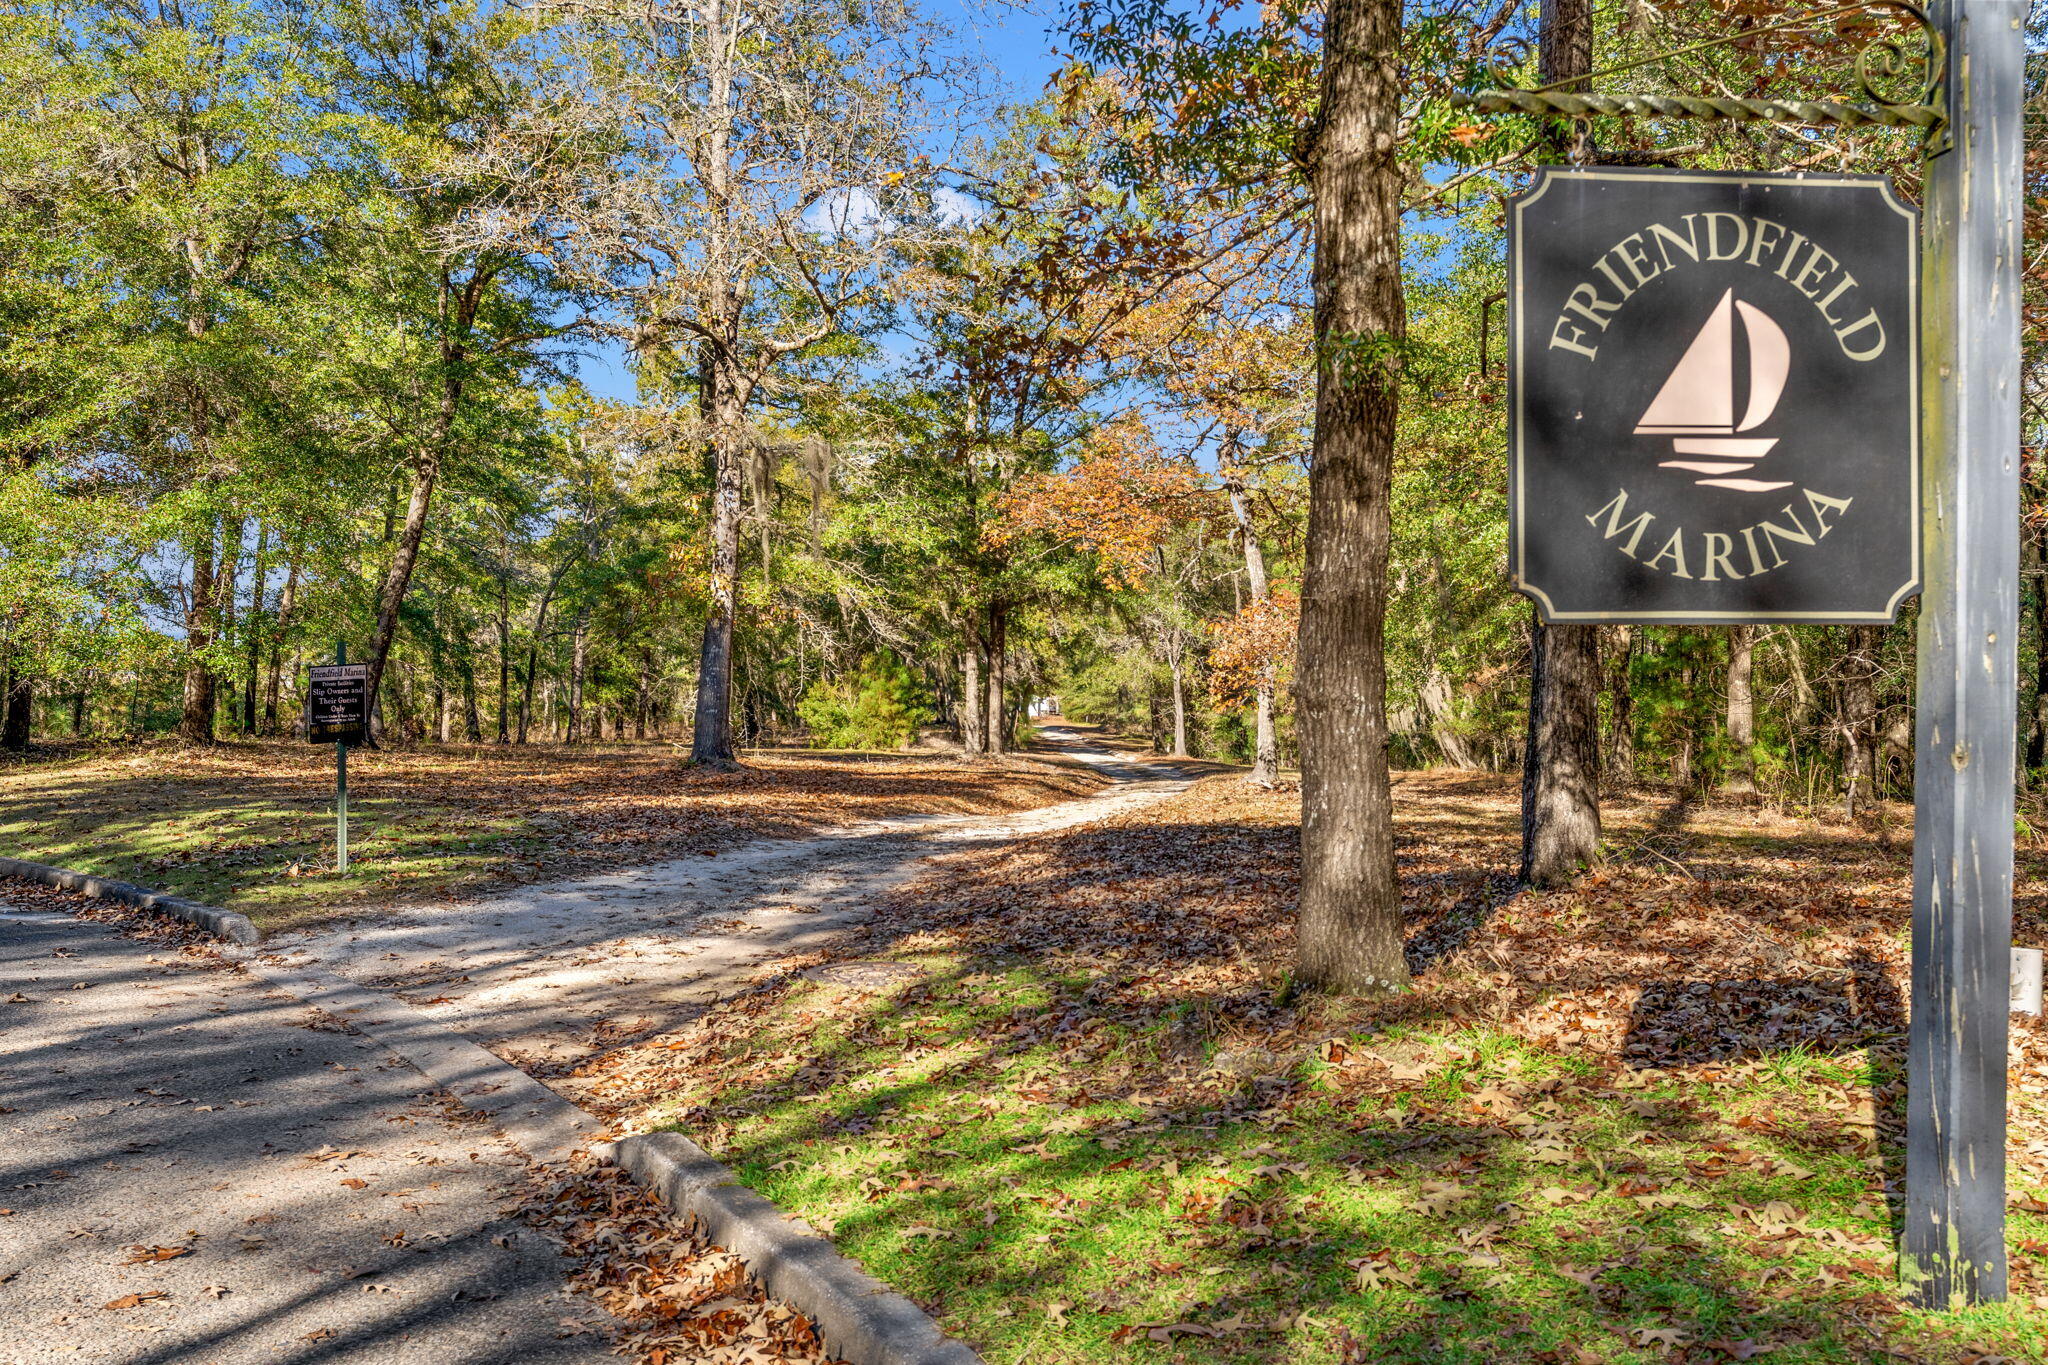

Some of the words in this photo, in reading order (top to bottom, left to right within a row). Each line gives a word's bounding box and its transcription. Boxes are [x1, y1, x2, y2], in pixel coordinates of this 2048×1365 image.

[1548, 211, 1887, 363] FRIENDFIELD
[1585, 488, 1853, 581] MARINA
[311, 668, 343, 678] Friendfield
[344, 667, 366, 677] Marina
[312, 688, 325, 696] Slip
[327, 687, 349, 695] Owners
[351, 686, 363, 694] and
[338, 696, 358, 704] Guests
[330, 705, 345, 713] Only
